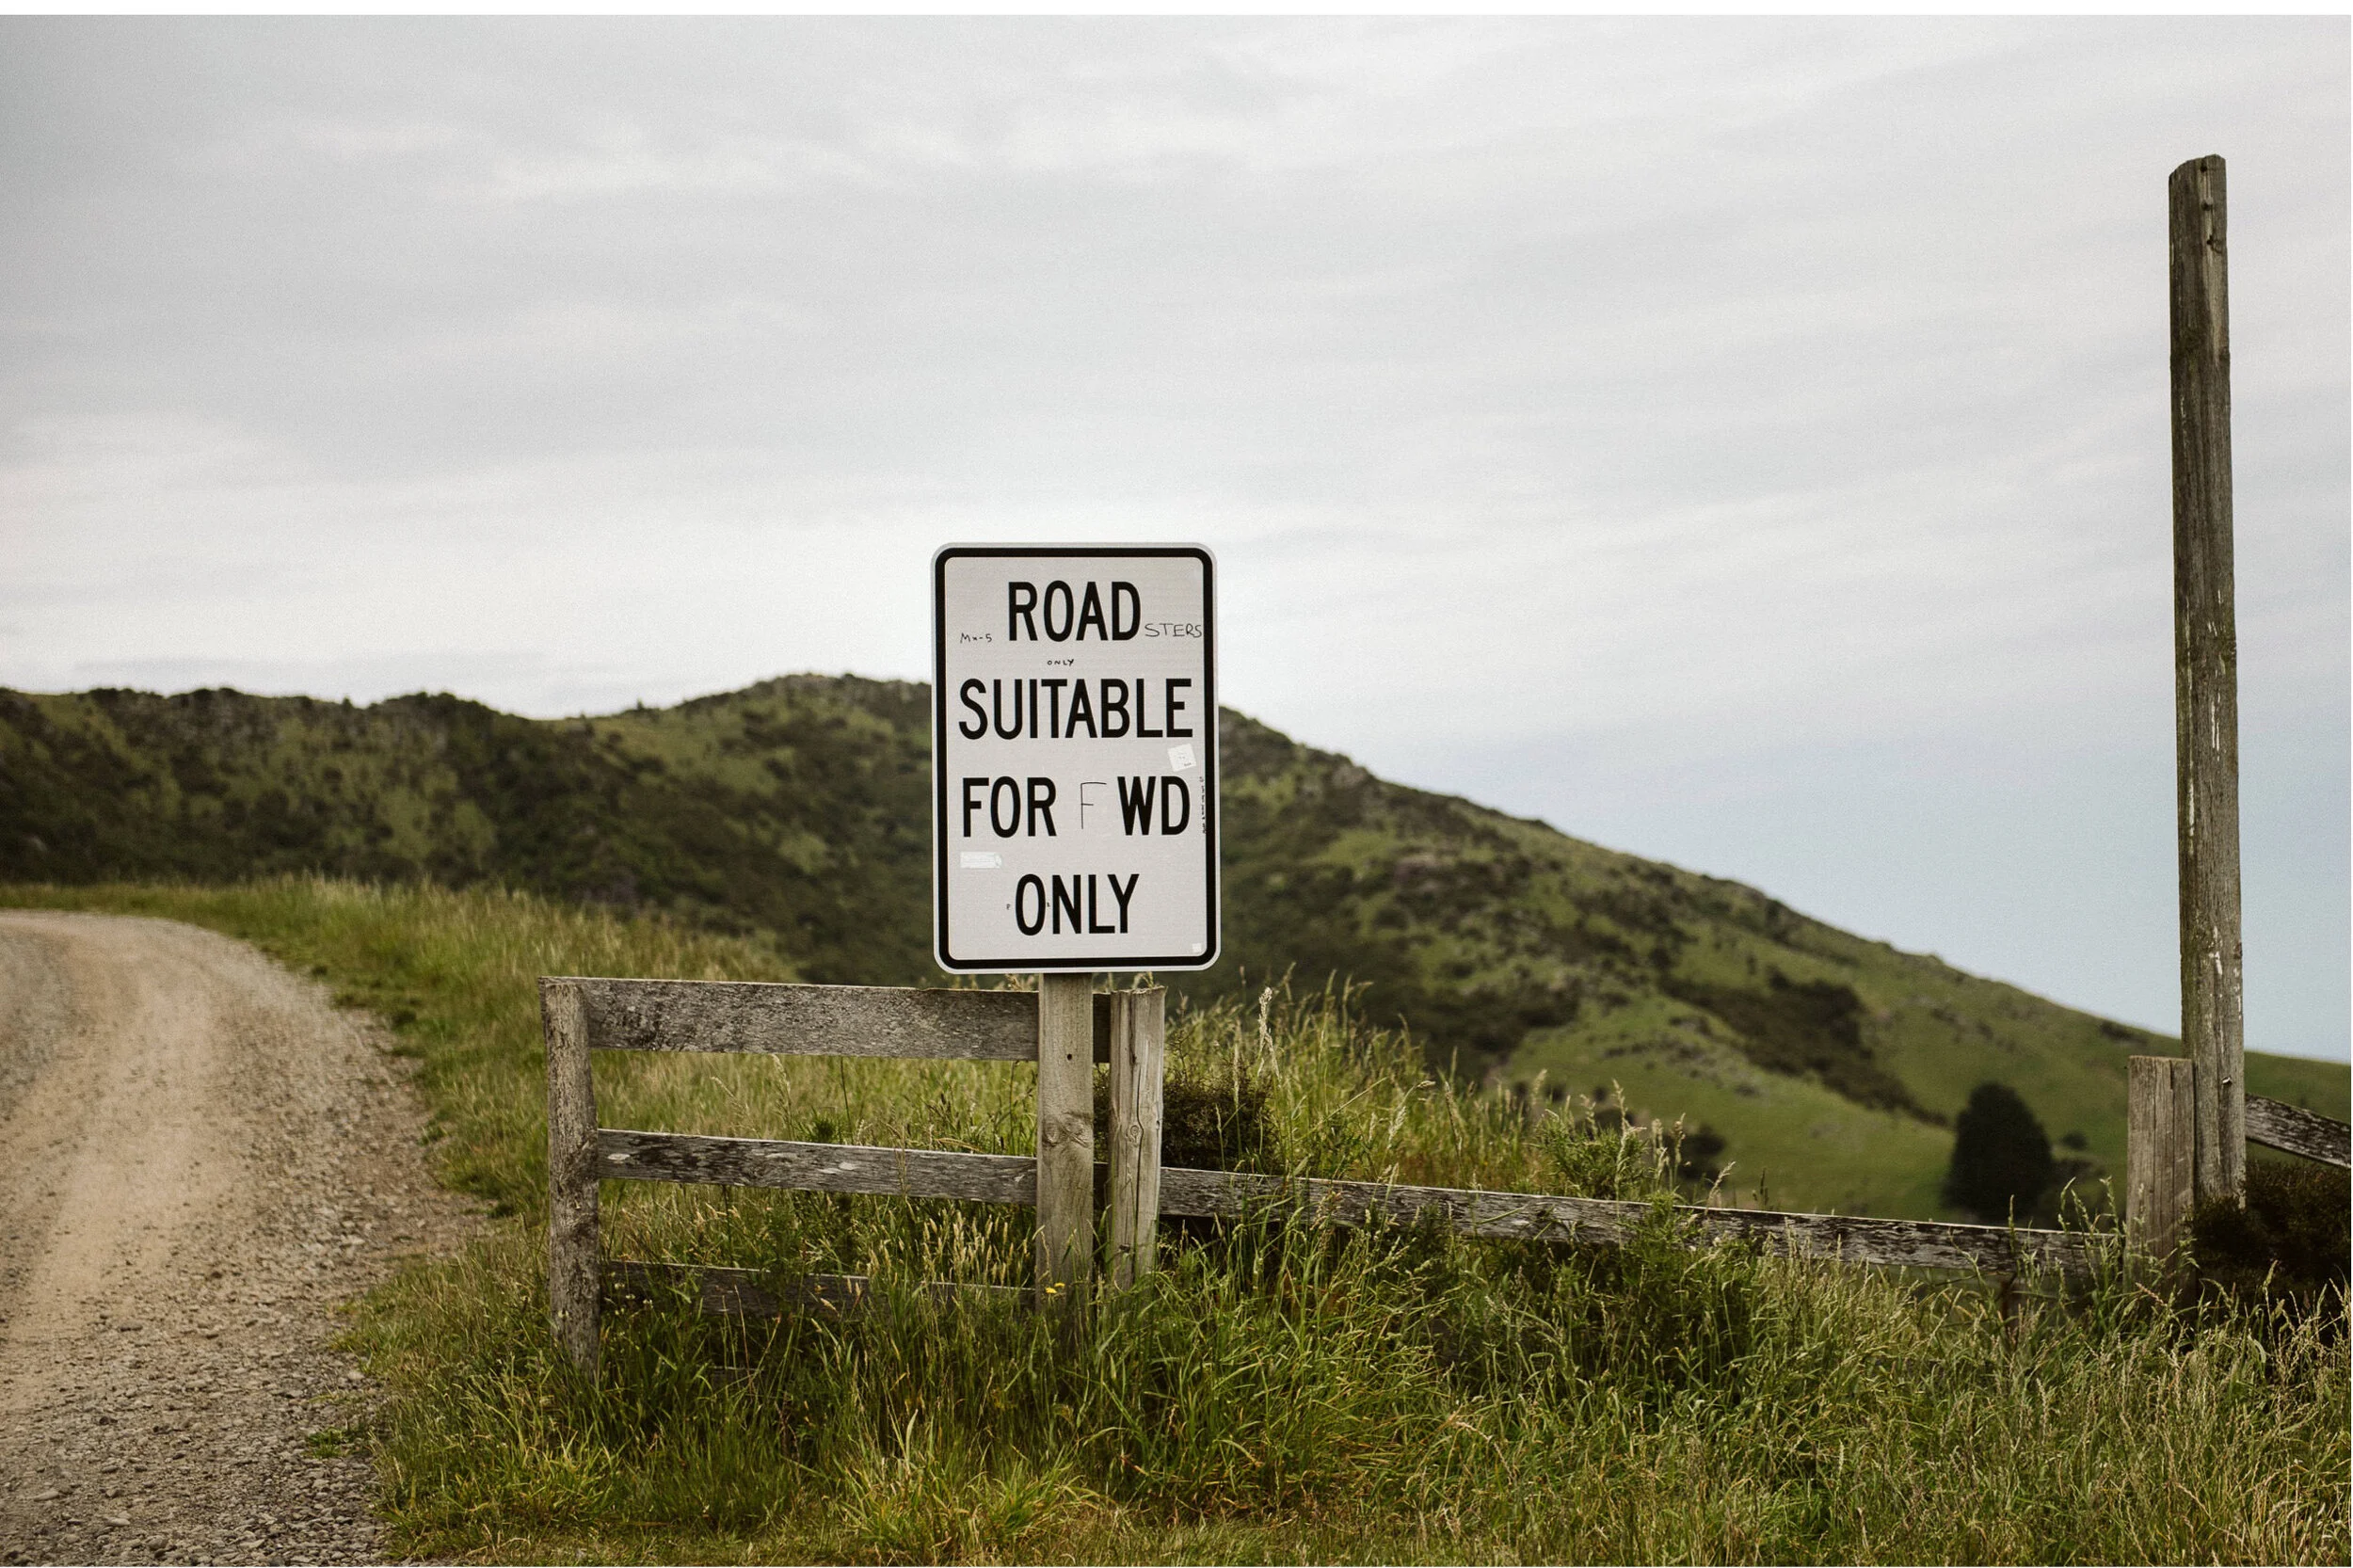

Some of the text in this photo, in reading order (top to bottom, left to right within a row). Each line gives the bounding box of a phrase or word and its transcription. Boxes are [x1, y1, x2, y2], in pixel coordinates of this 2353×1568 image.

[1009, 581, 1141, 642] ROAD
[1144, 623, 1202, 638] STERS
[959, 679, 1193, 740] SUITABLE
[963, 776, 1056, 838] FOR
[1117, 776, 1190, 835] WD
[1080, 782, 1106, 828] F
[1016, 874, 1139, 936] ONLY
